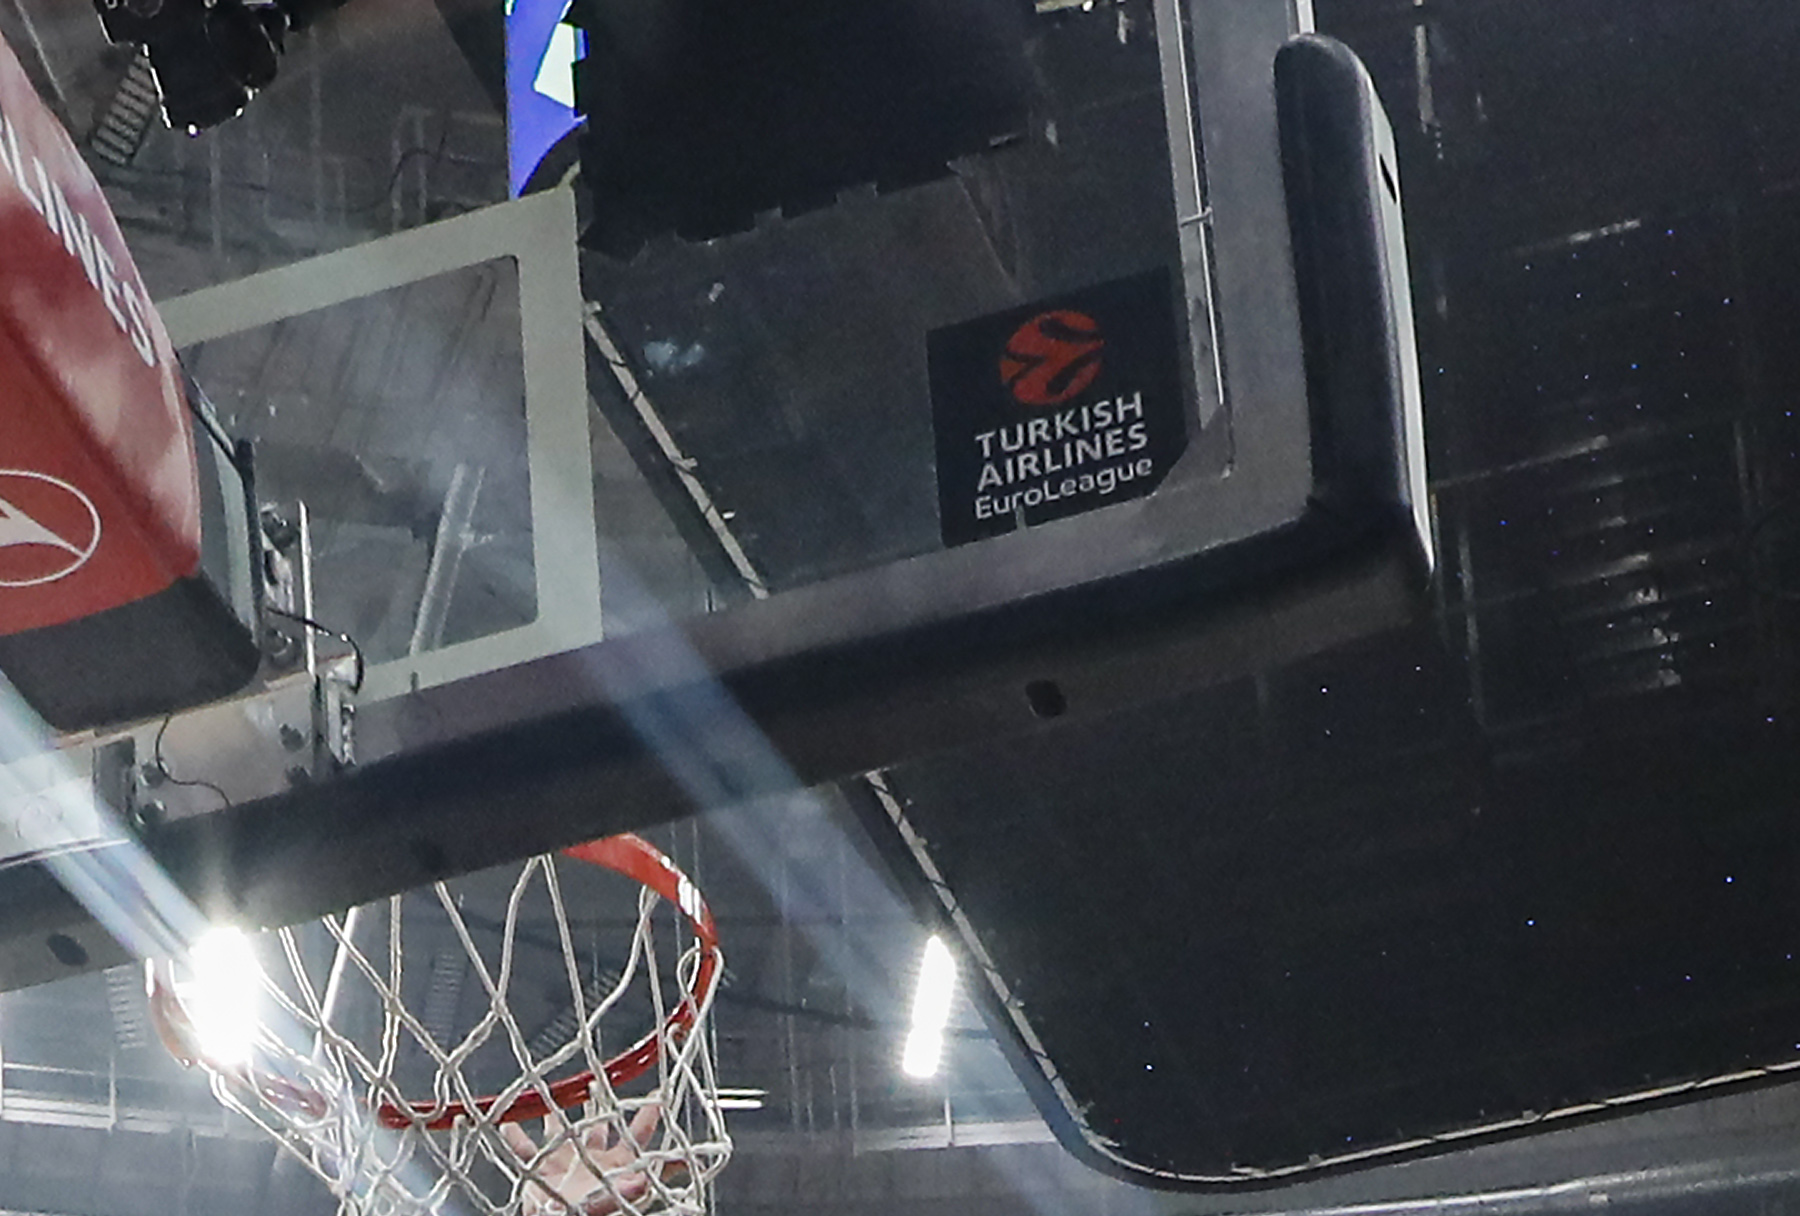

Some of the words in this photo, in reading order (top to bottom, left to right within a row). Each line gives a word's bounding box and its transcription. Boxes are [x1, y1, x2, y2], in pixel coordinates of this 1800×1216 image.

[975, 391, 1143, 457] TURKISH
[975, 457, 1153, 519] EuroLeague
[977, 424, 1148, 491] AIRLINES
